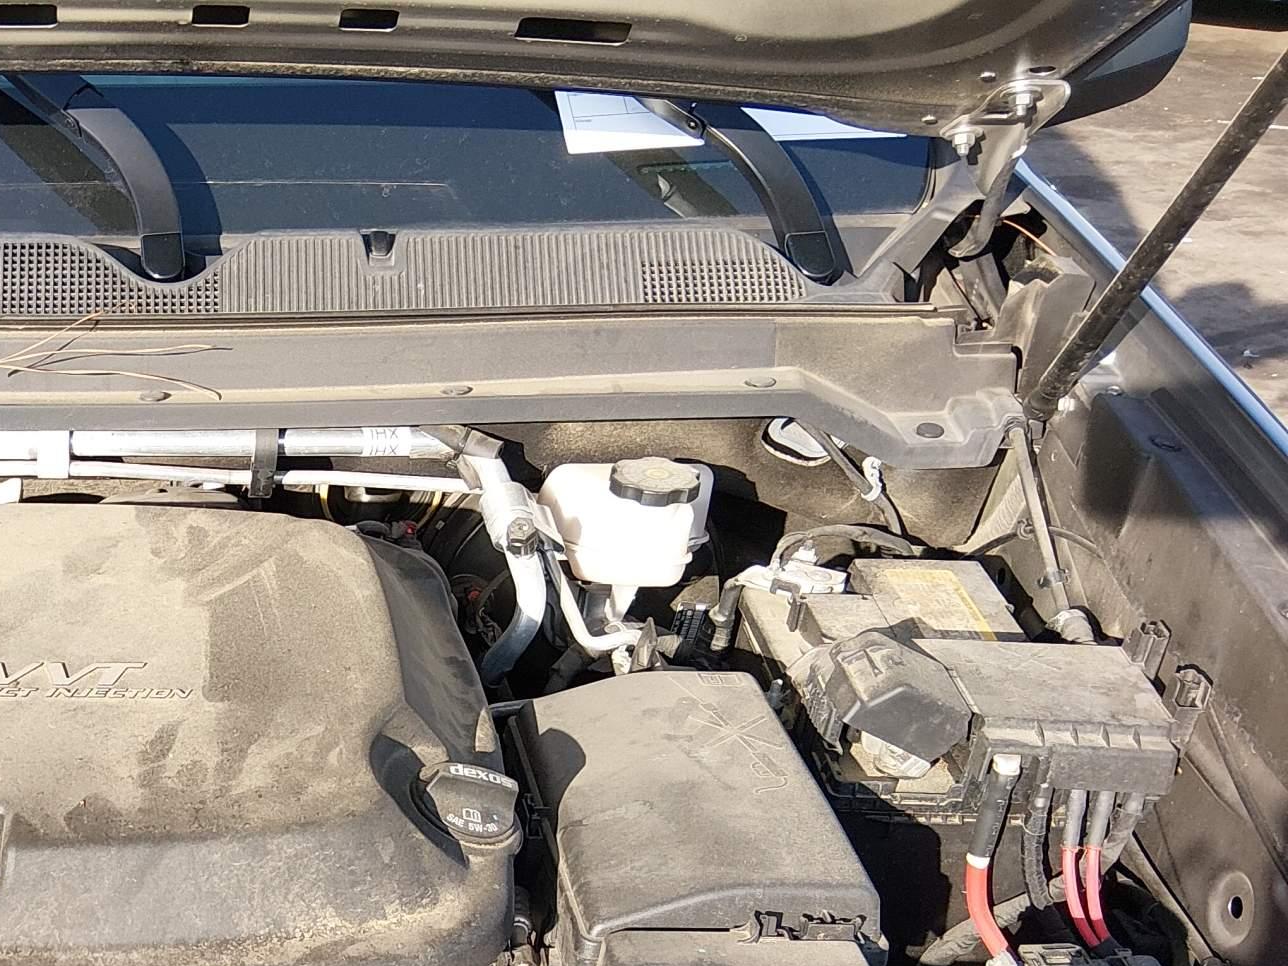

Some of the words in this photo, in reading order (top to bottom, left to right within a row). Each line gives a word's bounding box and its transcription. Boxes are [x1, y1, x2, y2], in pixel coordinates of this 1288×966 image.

[45, 686, 194, 700] INJECTION
[449, 763, 513, 789] dexos
[446, 813, 465, 828] SAE
[468, 822, 498, 833] 5W-30
